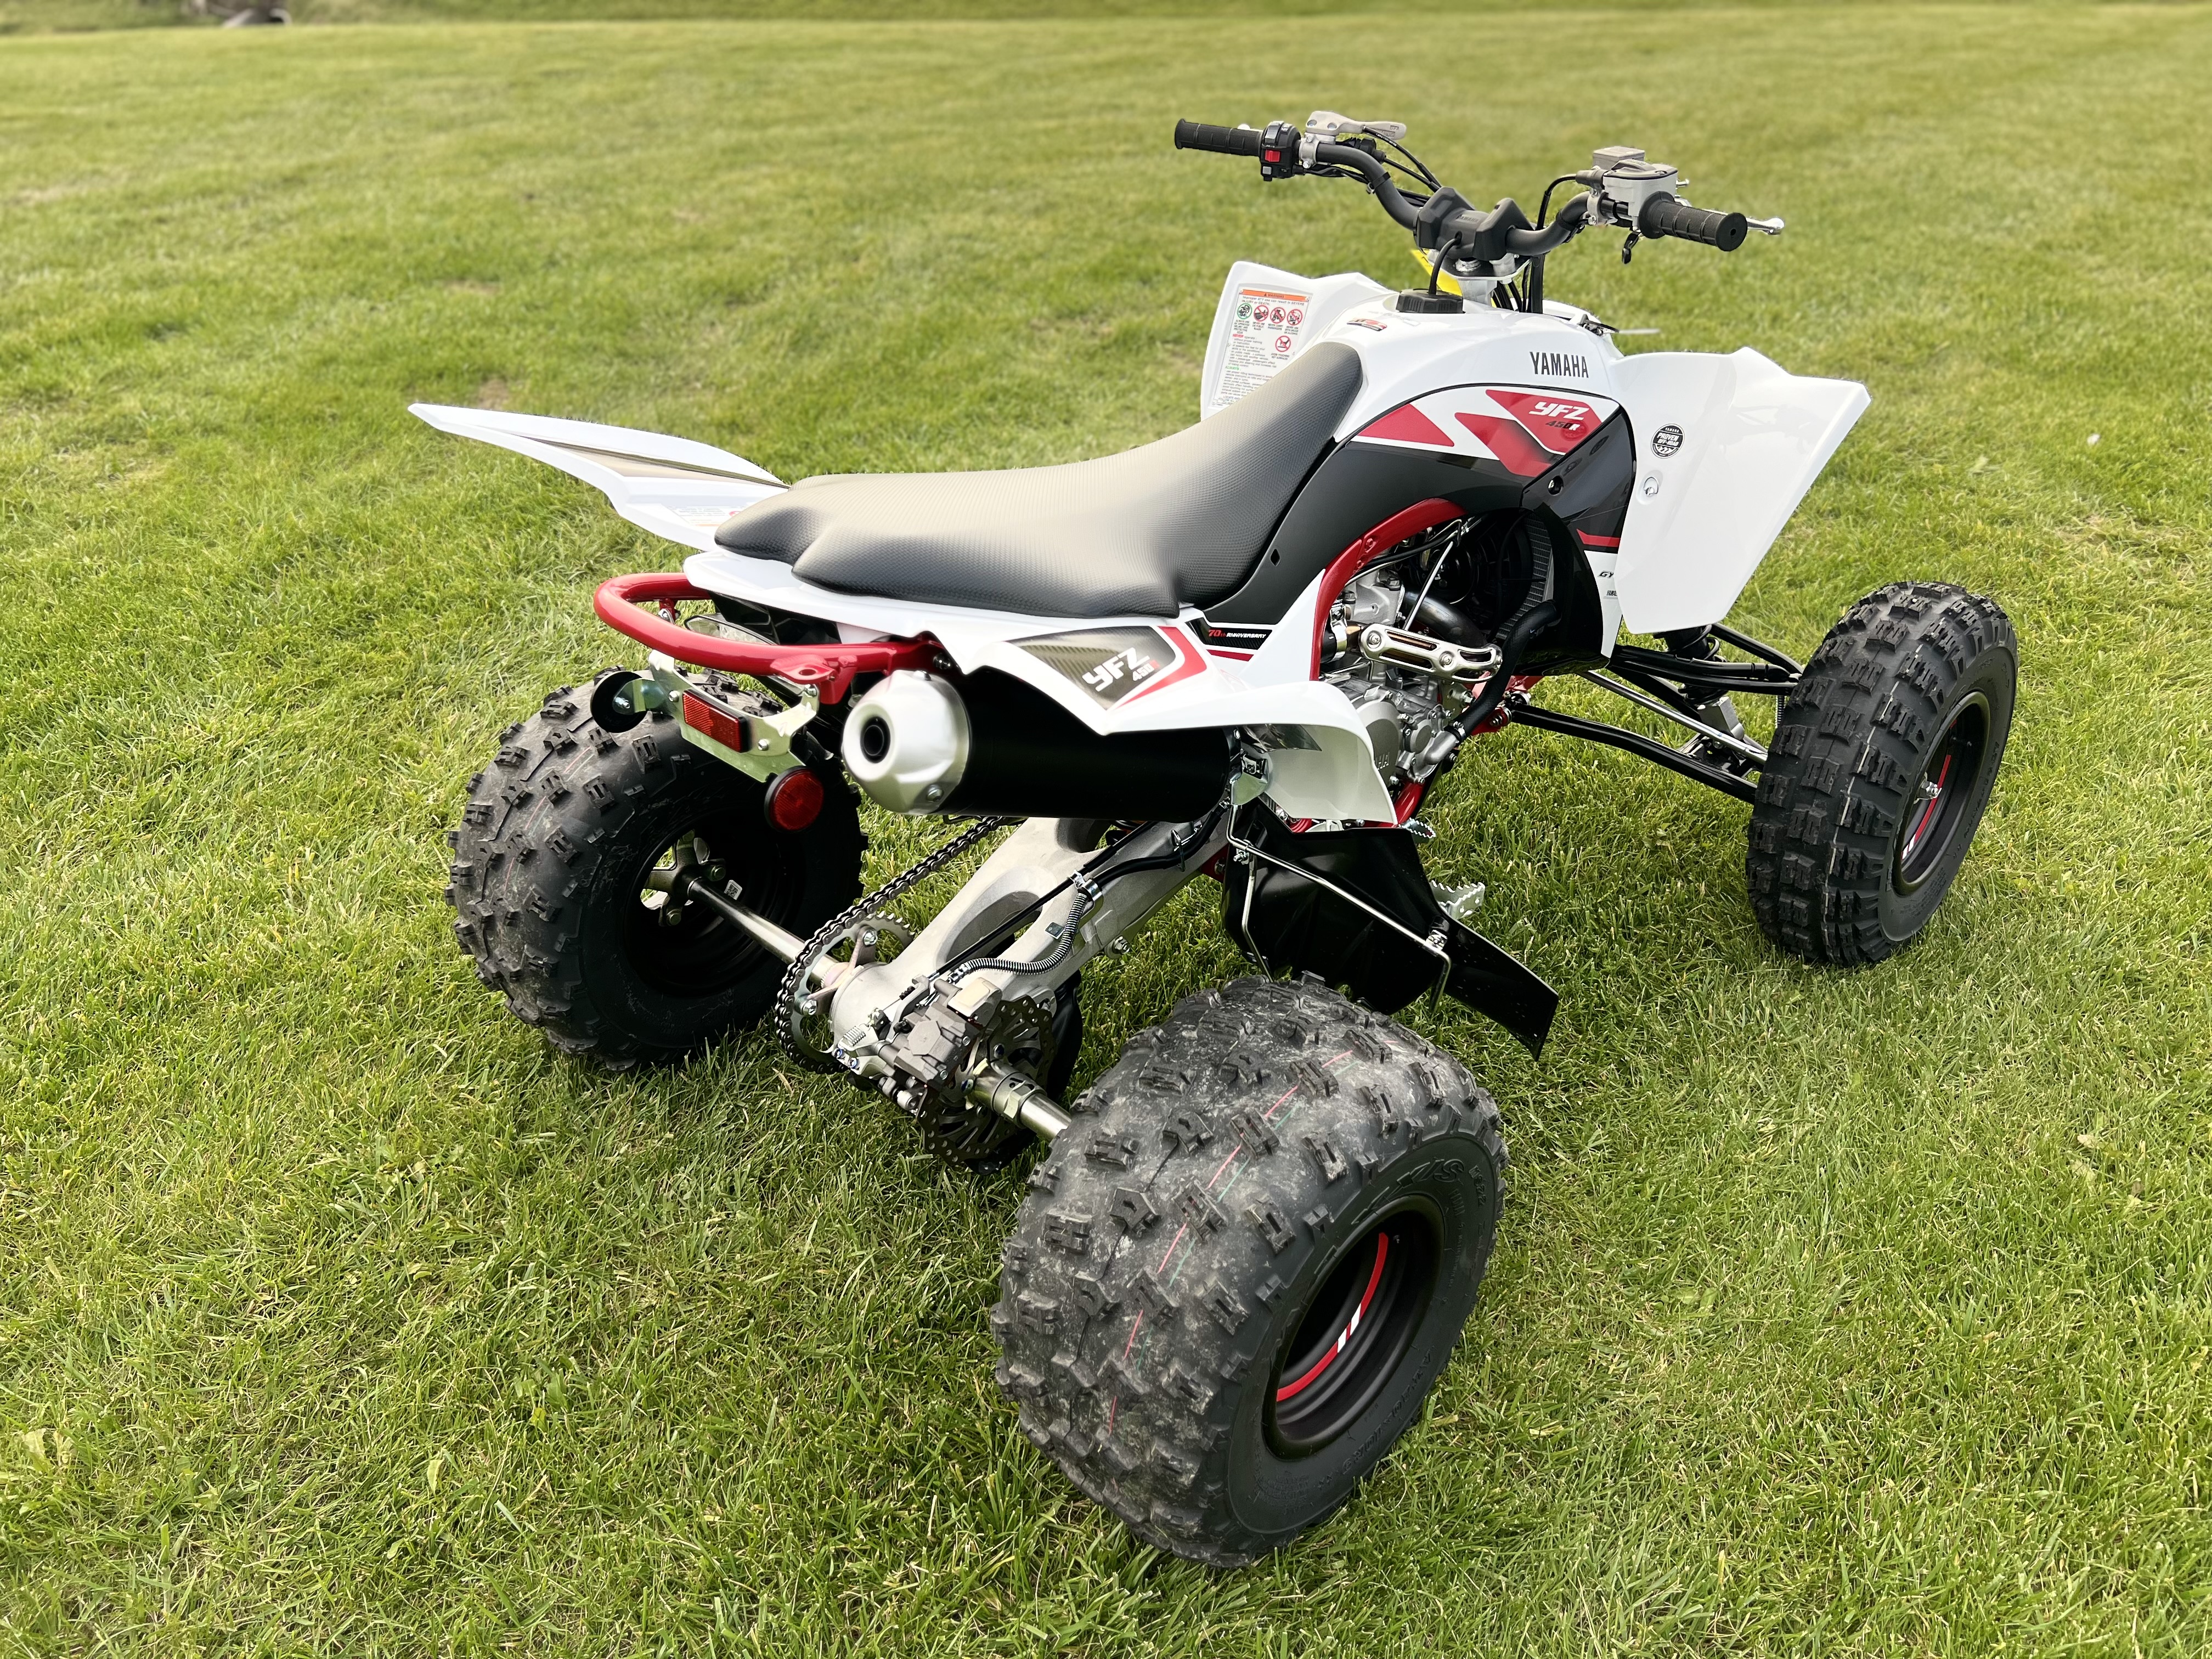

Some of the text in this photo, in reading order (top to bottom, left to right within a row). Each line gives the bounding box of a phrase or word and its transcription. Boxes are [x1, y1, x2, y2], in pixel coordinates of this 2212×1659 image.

[1530, 352, 1589, 378] YAMAHA
[1528, 402, 1589, 420] YFZ
[1545, 420, 1580, 431] 450R
[1657, 432, 1679, 441] PROVEN
[1657, 438, 1679, 447] OFF-ROAD
[1082, 647, 1150, 692] YFZ
